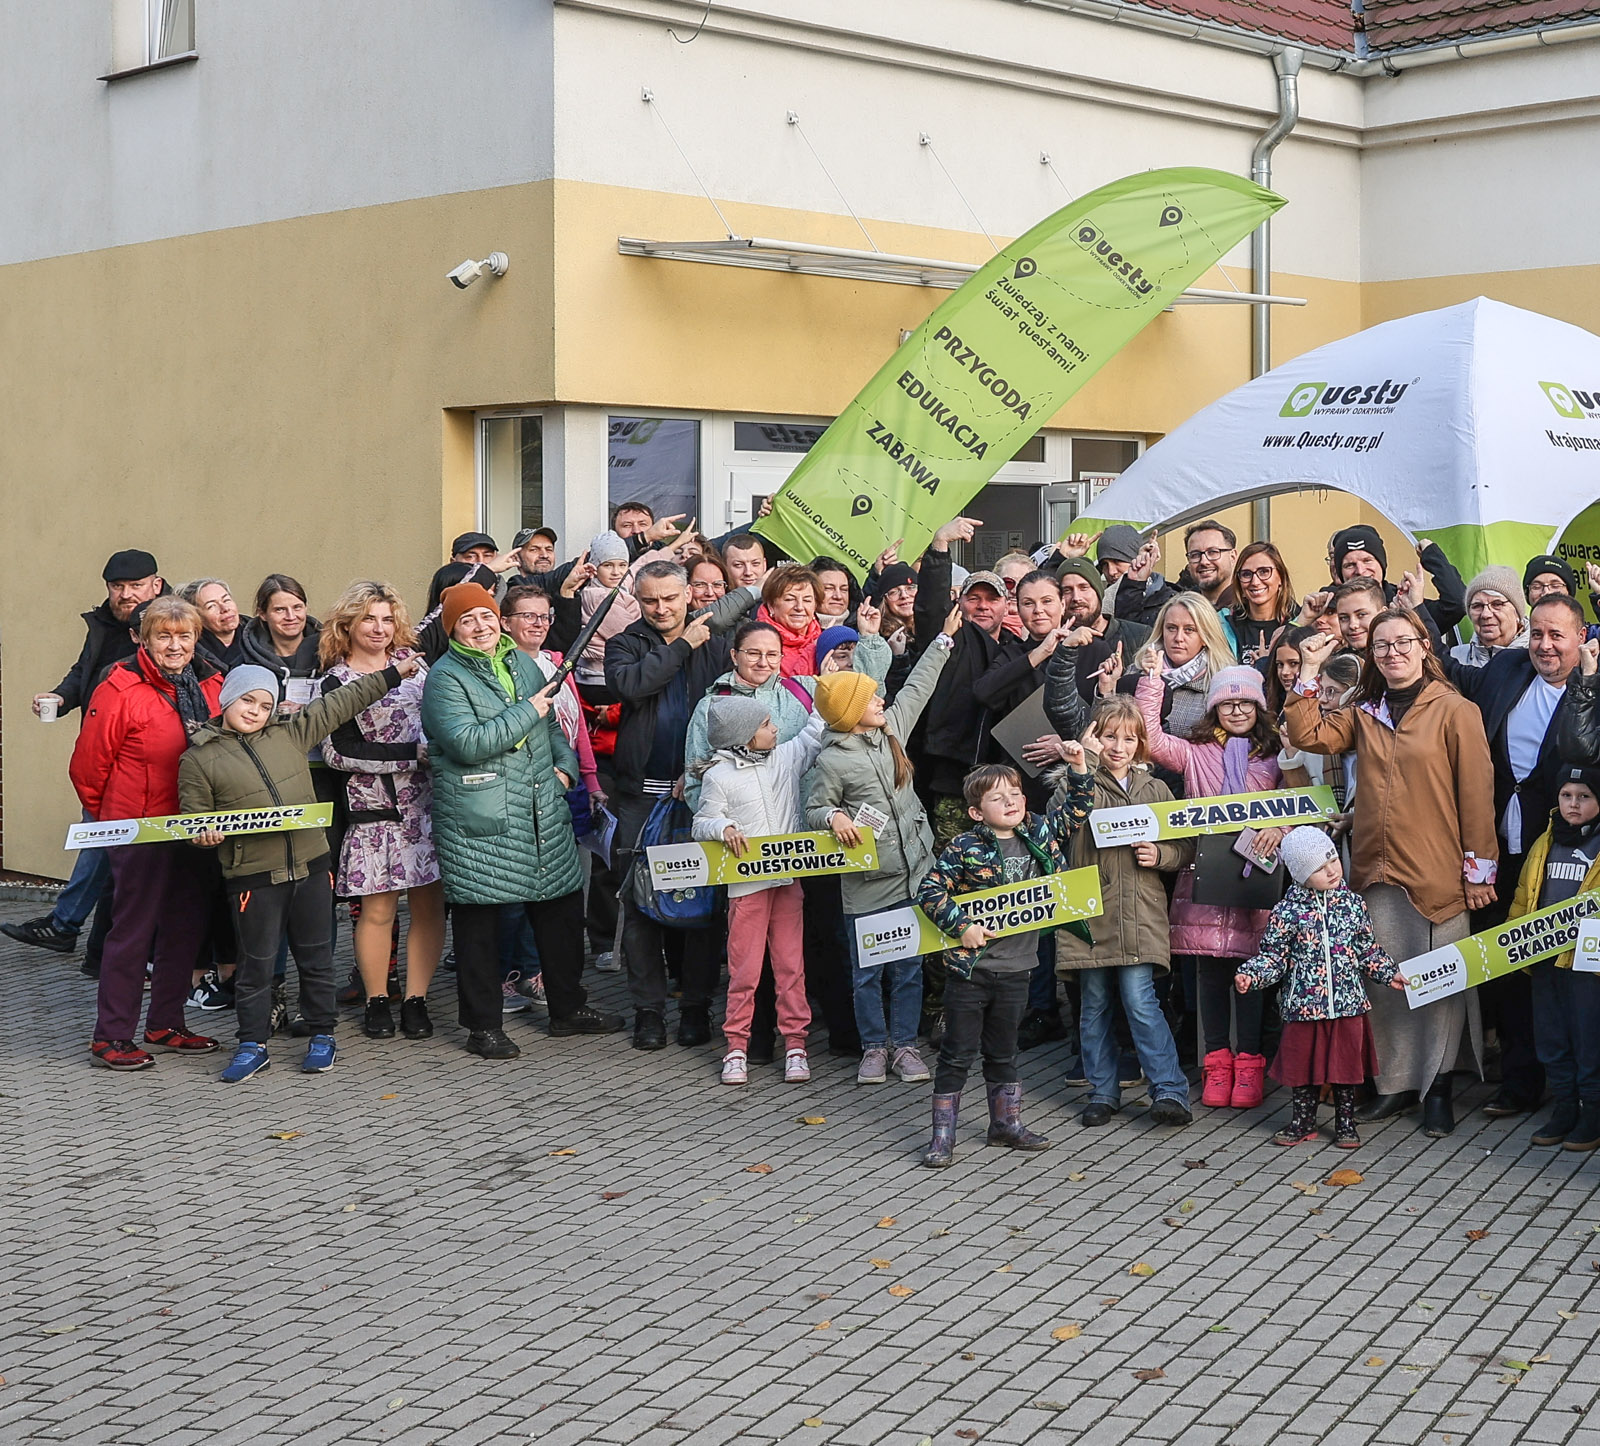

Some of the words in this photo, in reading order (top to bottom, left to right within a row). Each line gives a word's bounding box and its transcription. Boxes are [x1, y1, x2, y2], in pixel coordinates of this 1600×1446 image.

[1018, 320, 1077, 374] questami!
[1047, 324, 1058, 334] z
[1056, 332, 1090, 363] nami
[933, 325, 1032, 421] PRZYGODA
[1278, 378, 1410, 418] Questy
[1313, 408, 1352, 416] WYPRAWY
[1352, 406, 1396, 415] ODKRYWCÓW
[896, 369, 989, 461] EDUKACJA
[1262, 430, 1385, 453] www.Questy.org.pl
[865, 419, 941, 497] ZABAWA
[785, 489, 871, 574] www.Questy.org.
[165, 808, 305, 829] POSZUKIWACZ
[1096, 818, 1149, 834] Questy
[1168, 795, 1320, 827] #ZABAWA
[760, 838, 817, 857] SUPER
[653, 858, 700, 875] Questy
[736, 852, 847, 878] QUESTOWICZ
[1546, 862, 1587, 882] PUMA
[960, 884, 1053, 917] TROPICIEL
[862, 926, 911, 950] Questy
[1497, 899, 1600, 948] ODKRYWCA
[1507, 923, 1580, 965] SKARBÓ
[1408, 962, 1457, 991] Questy
